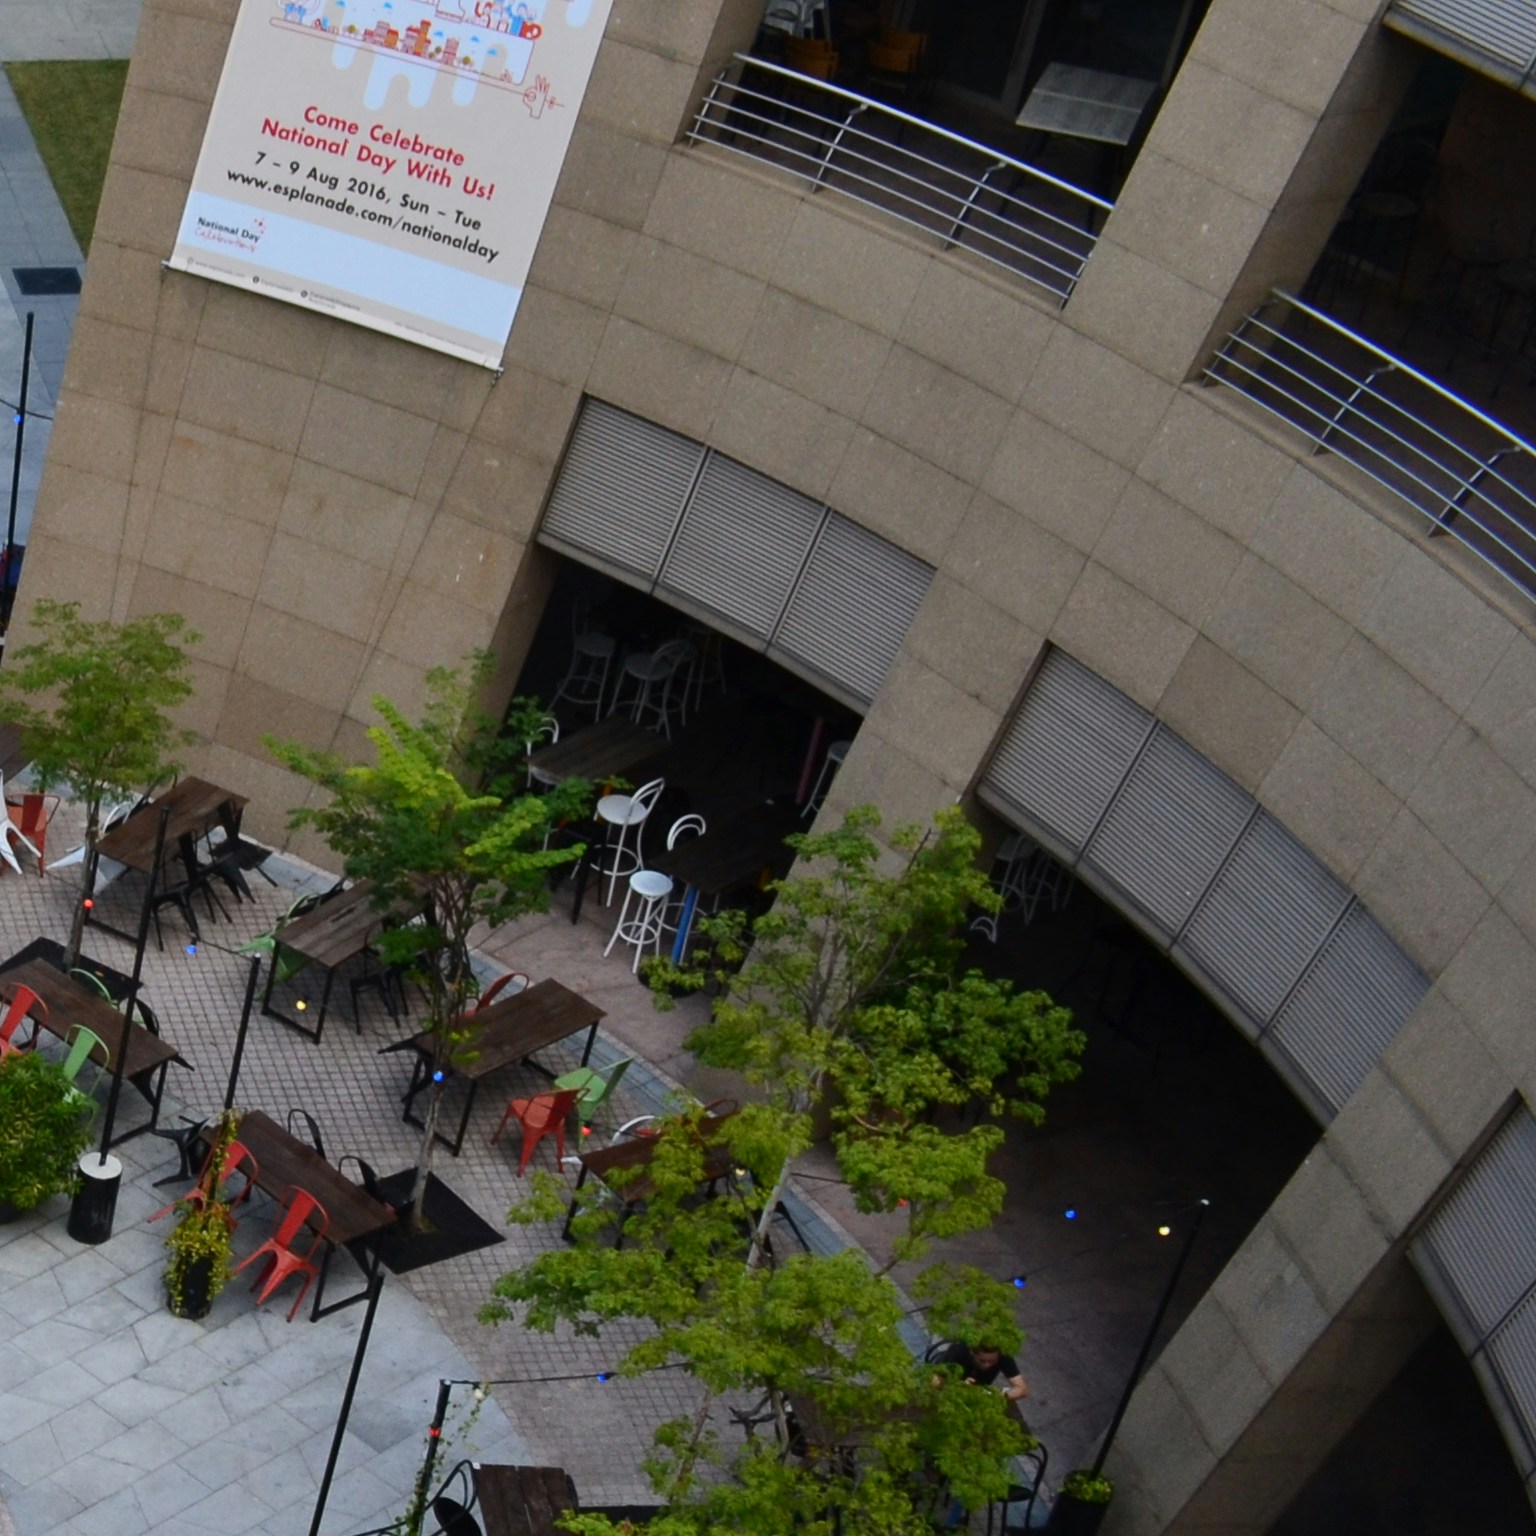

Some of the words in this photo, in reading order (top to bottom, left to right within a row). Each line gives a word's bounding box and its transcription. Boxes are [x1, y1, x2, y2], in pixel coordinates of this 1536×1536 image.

[261, 118, 349, 156] National
[357, 144, 396, 175] Day
[407, 158, 452, 188] With
[463, 176, 495, 201] Us!
[304, 106, 359, 135] Come
[370, 125, 465, 166] Celebrate
[197, 217, 239, 235] National
[241, 229, 261, 243] Day
[228, 170, 499, 263] www.esplanade.com/nationalday
[255, 152, 266, 165] 7
[289, 161, 300, 175] 9
[306, 167, 339, 190] Aug
[348, 178, 391, 204] 2016,
[400, 194, 430, 214] Sun
[454, 210, 481, 230] Tue
